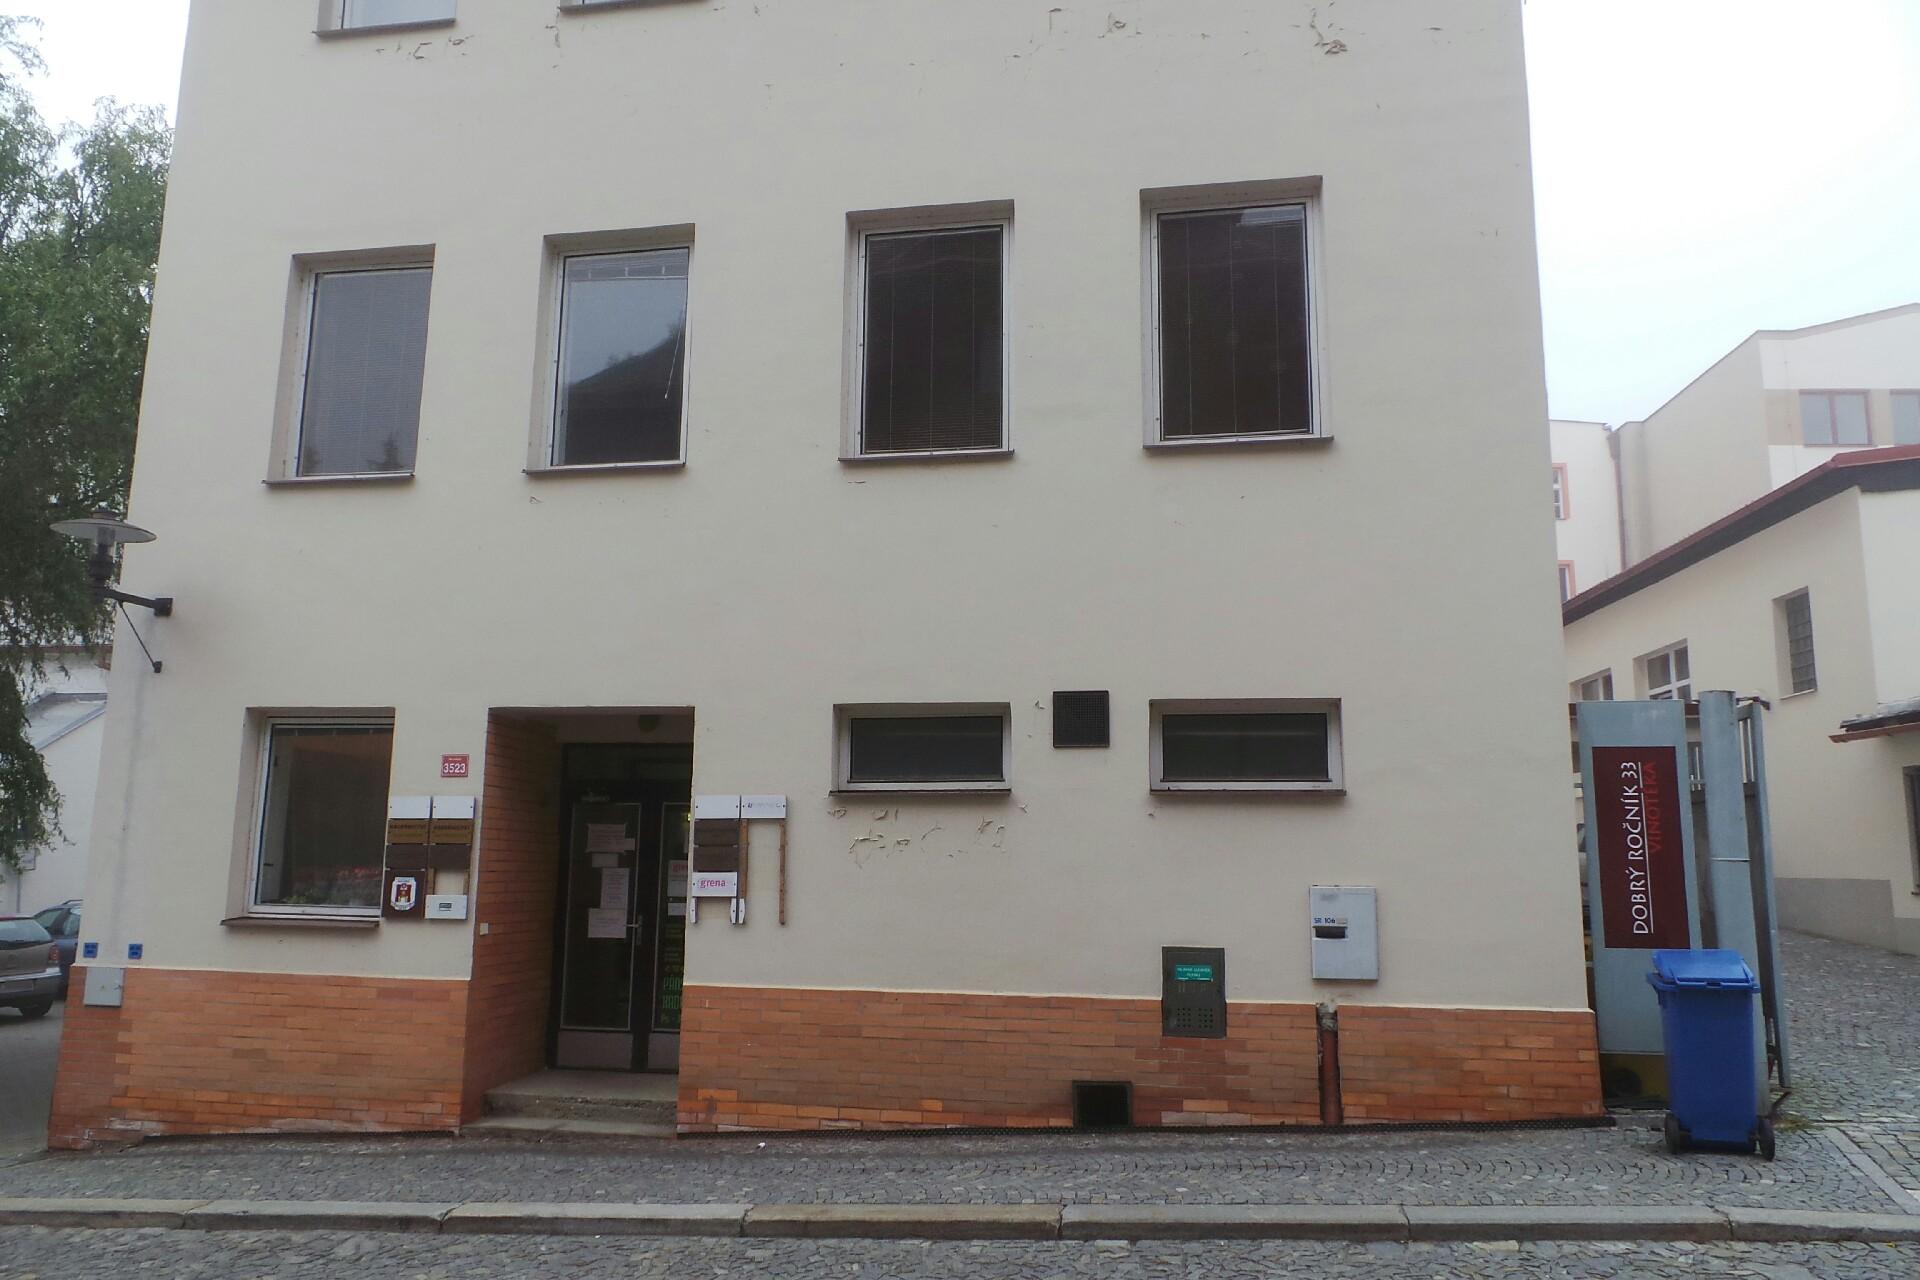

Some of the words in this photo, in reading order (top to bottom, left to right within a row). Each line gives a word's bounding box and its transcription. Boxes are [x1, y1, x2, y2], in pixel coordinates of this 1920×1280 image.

[443, 763, 466, 773] 3523
[1620, 762, 1638, 779] 33
[1620, 785, 1644, 860] ROČNÍK
[699, 879, 726, 889] grena
[1625, 867, 1649, 934] DOBRÝ
